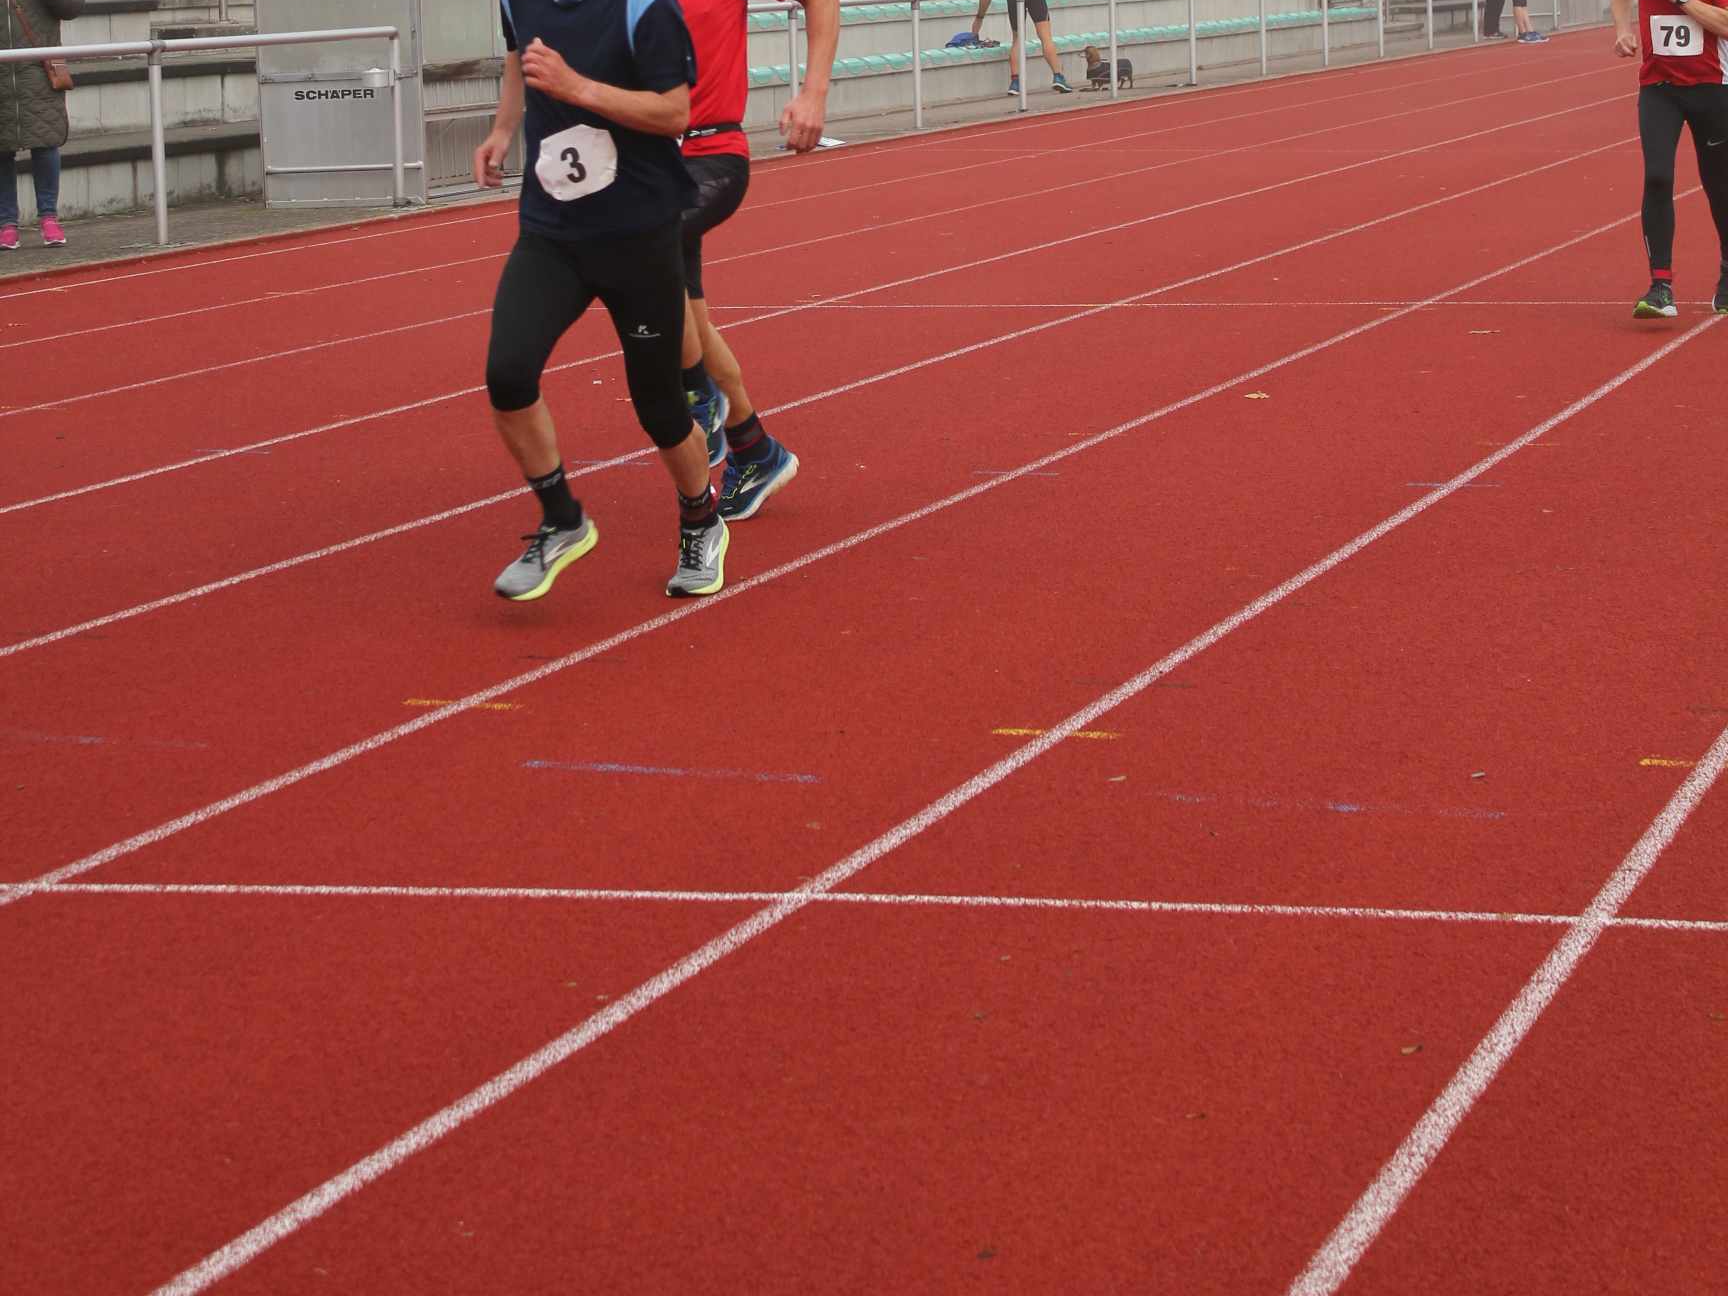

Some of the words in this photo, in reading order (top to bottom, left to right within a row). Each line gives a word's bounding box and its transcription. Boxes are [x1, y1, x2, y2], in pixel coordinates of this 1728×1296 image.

[1660, 25, 1691, 47] 79
[294, 88, 375, 101] SCHÄPER
[560, 147, 587, 183] 3
